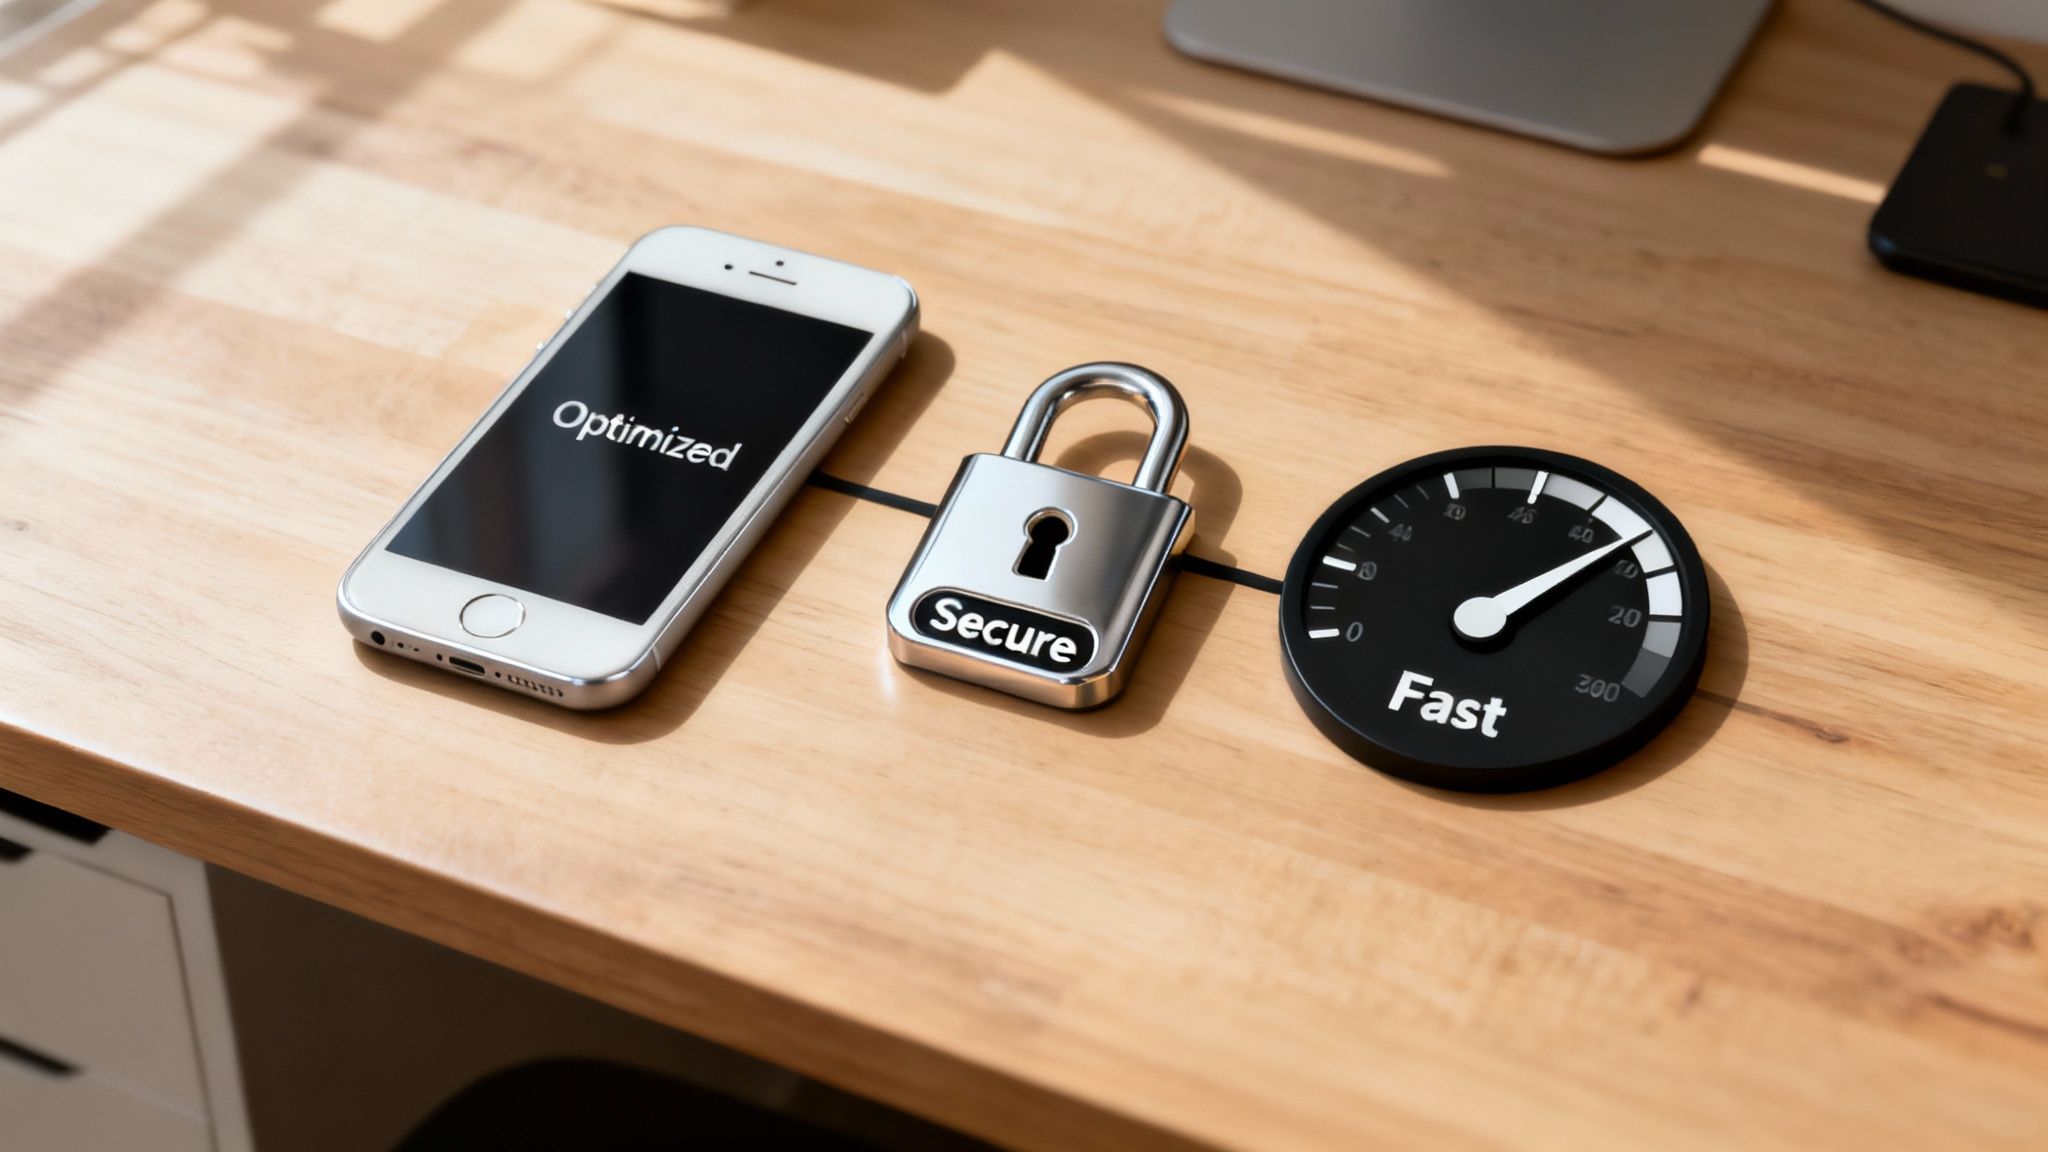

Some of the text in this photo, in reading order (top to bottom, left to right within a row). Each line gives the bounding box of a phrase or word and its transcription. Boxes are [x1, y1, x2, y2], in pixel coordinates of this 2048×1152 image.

[552, 400, 743, 471] Optimized
[929, 597, 1077, 663] Secure
[1346, 621, 1363, 642] 0
[1608, 605, 1642, 628] 20
[1388, 670, 1507, 738] Fast
